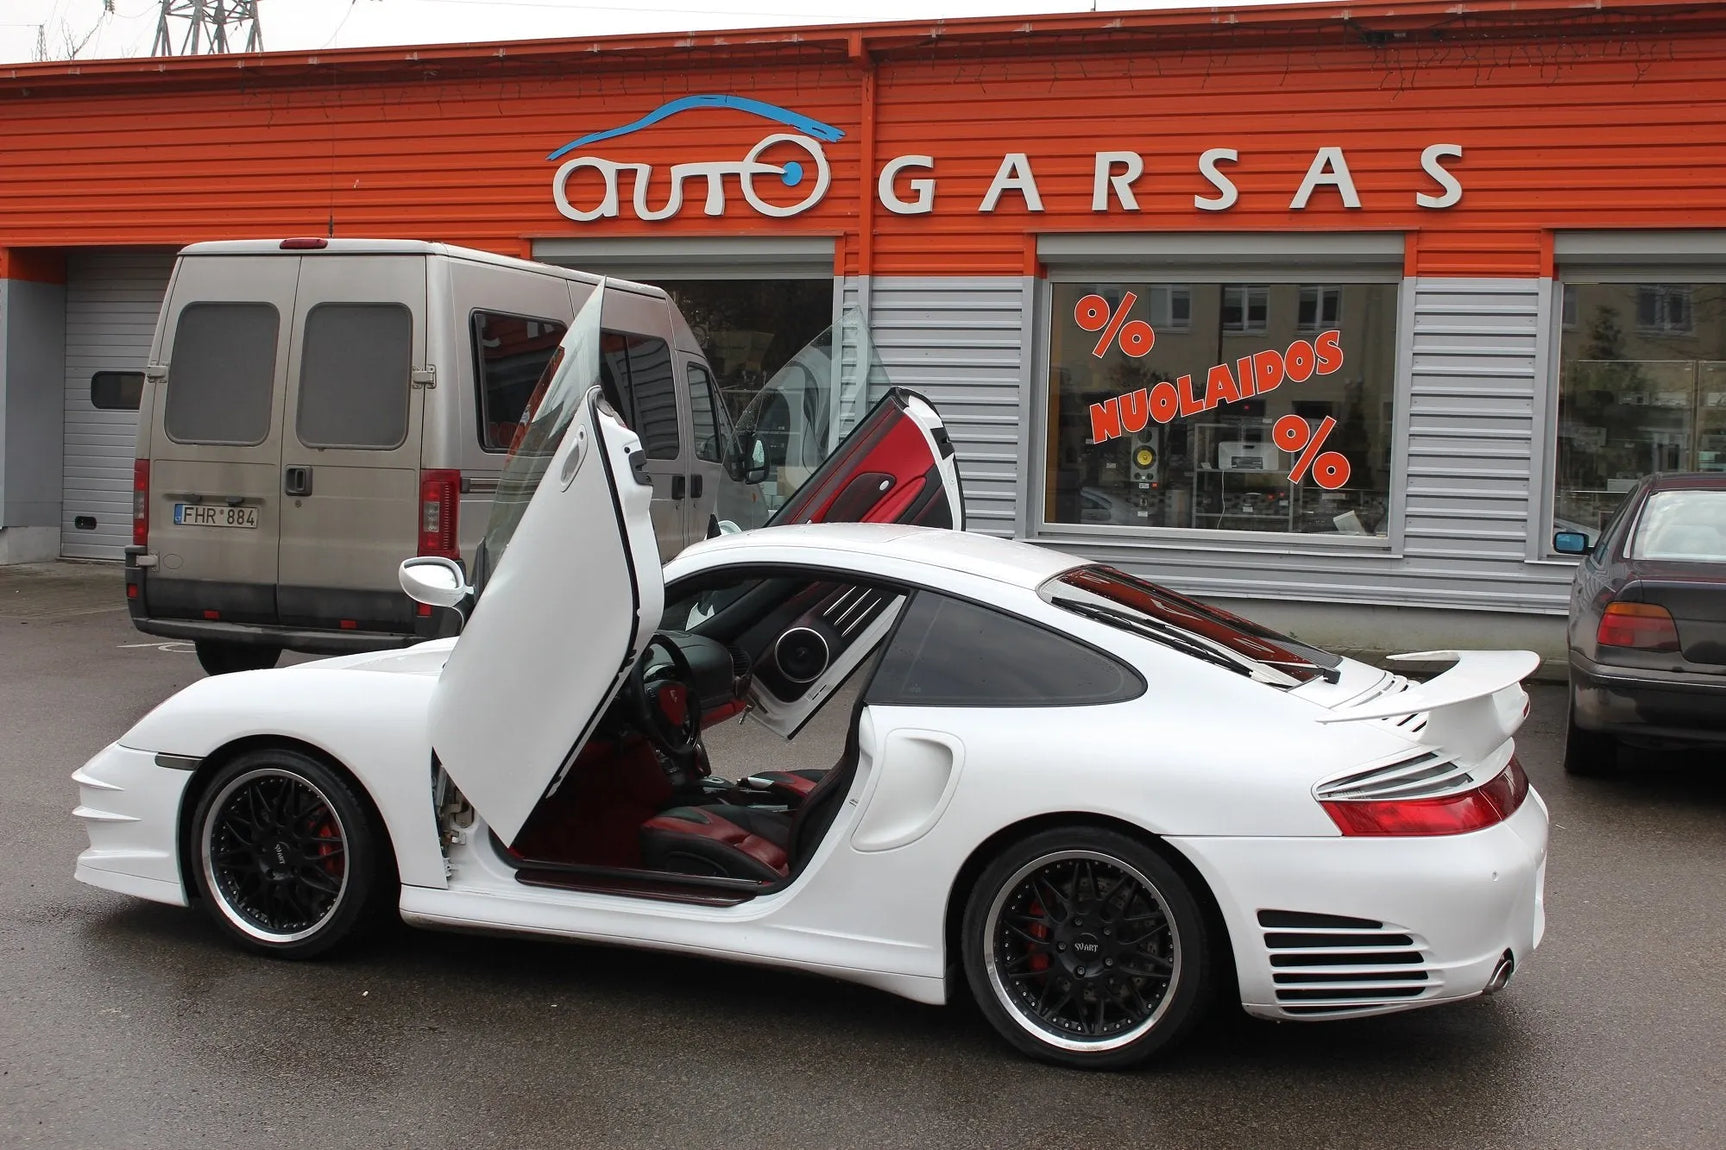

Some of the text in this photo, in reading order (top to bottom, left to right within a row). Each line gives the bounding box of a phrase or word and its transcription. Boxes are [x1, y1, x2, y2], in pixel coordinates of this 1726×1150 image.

[877, 143, 1464, 214] GARSAS
[1073, 290, 1156, 360] %
[1089, 329, 1345, 445] NUOLAIDOS
[1271, 414, 1352, 491] %
[183, 506, 255, 526] FHR 884
